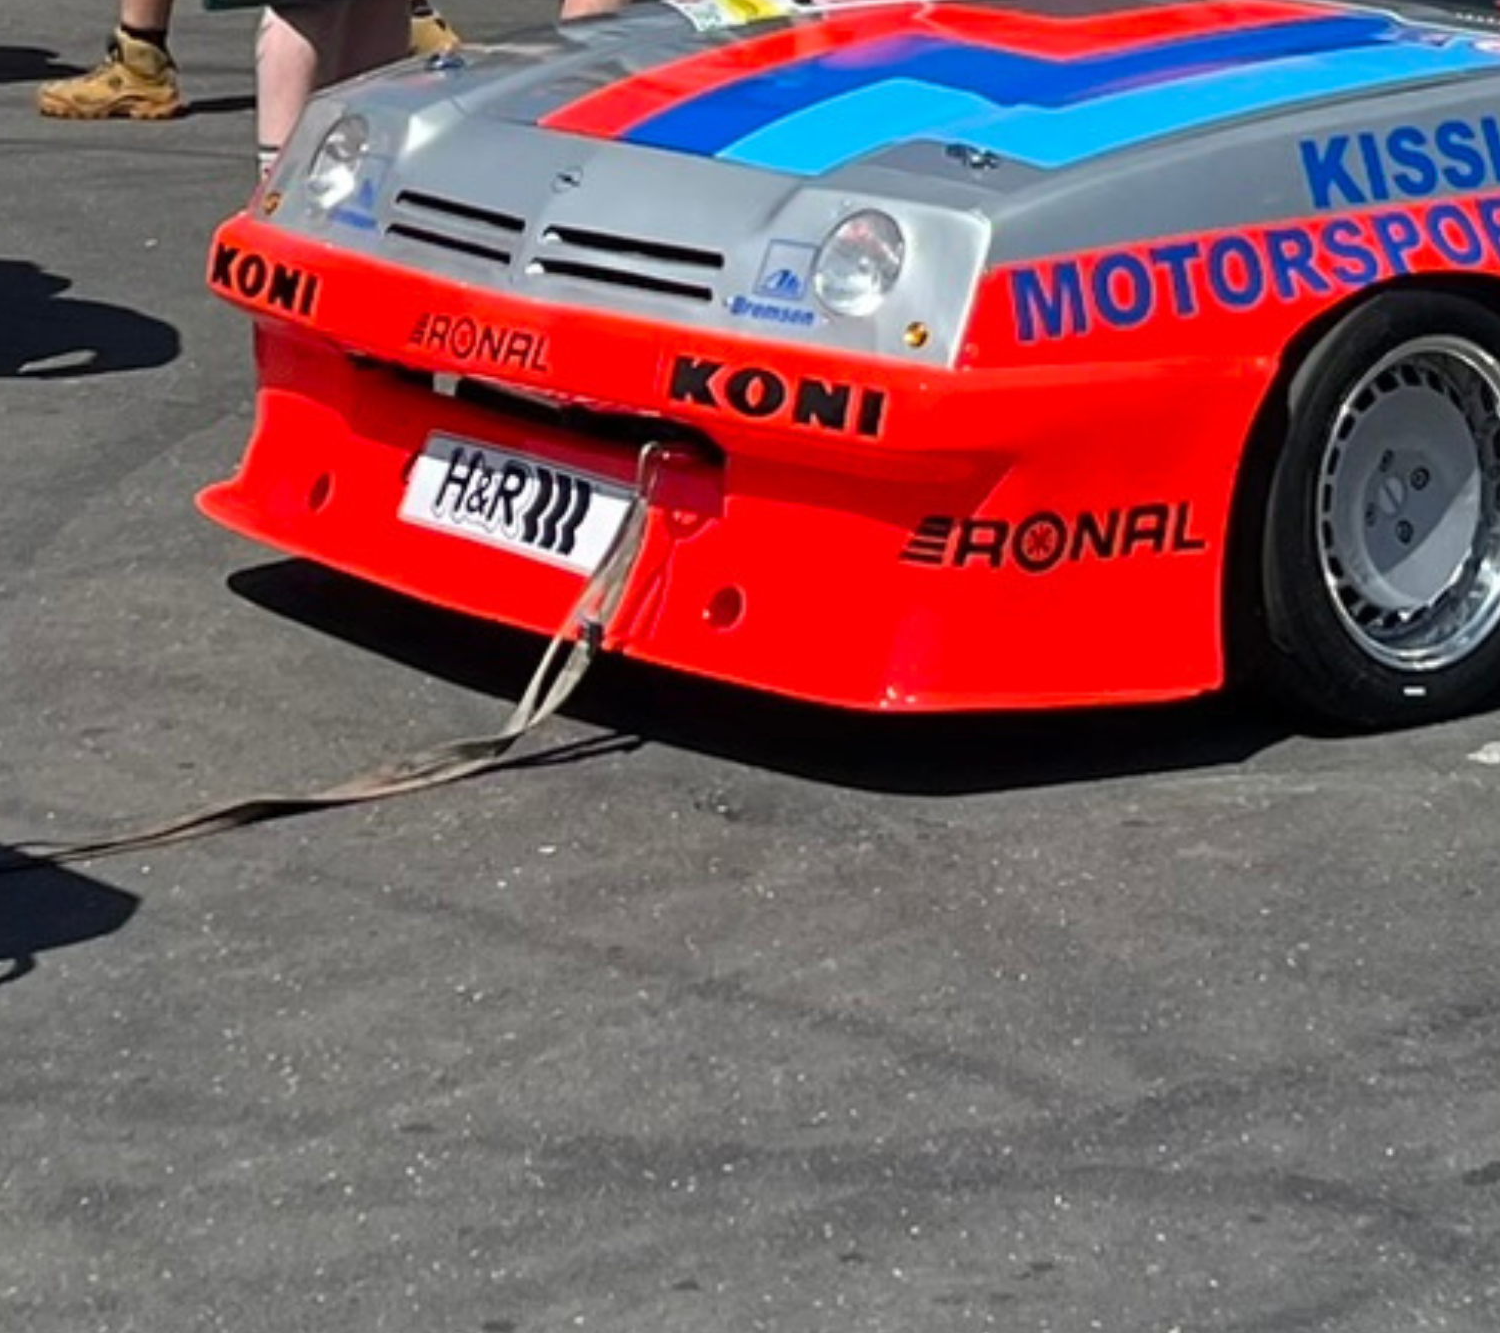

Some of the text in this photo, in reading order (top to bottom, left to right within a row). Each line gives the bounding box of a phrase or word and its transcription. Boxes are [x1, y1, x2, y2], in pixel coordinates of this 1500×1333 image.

[211, 243, 319, 319] KONI
[422, 314, 548, 371] RONAL
[668, 354, 886, 437] KONI
[432, 446, 527, 528] H&R
[953, 502, 1206, 574] RONAL
